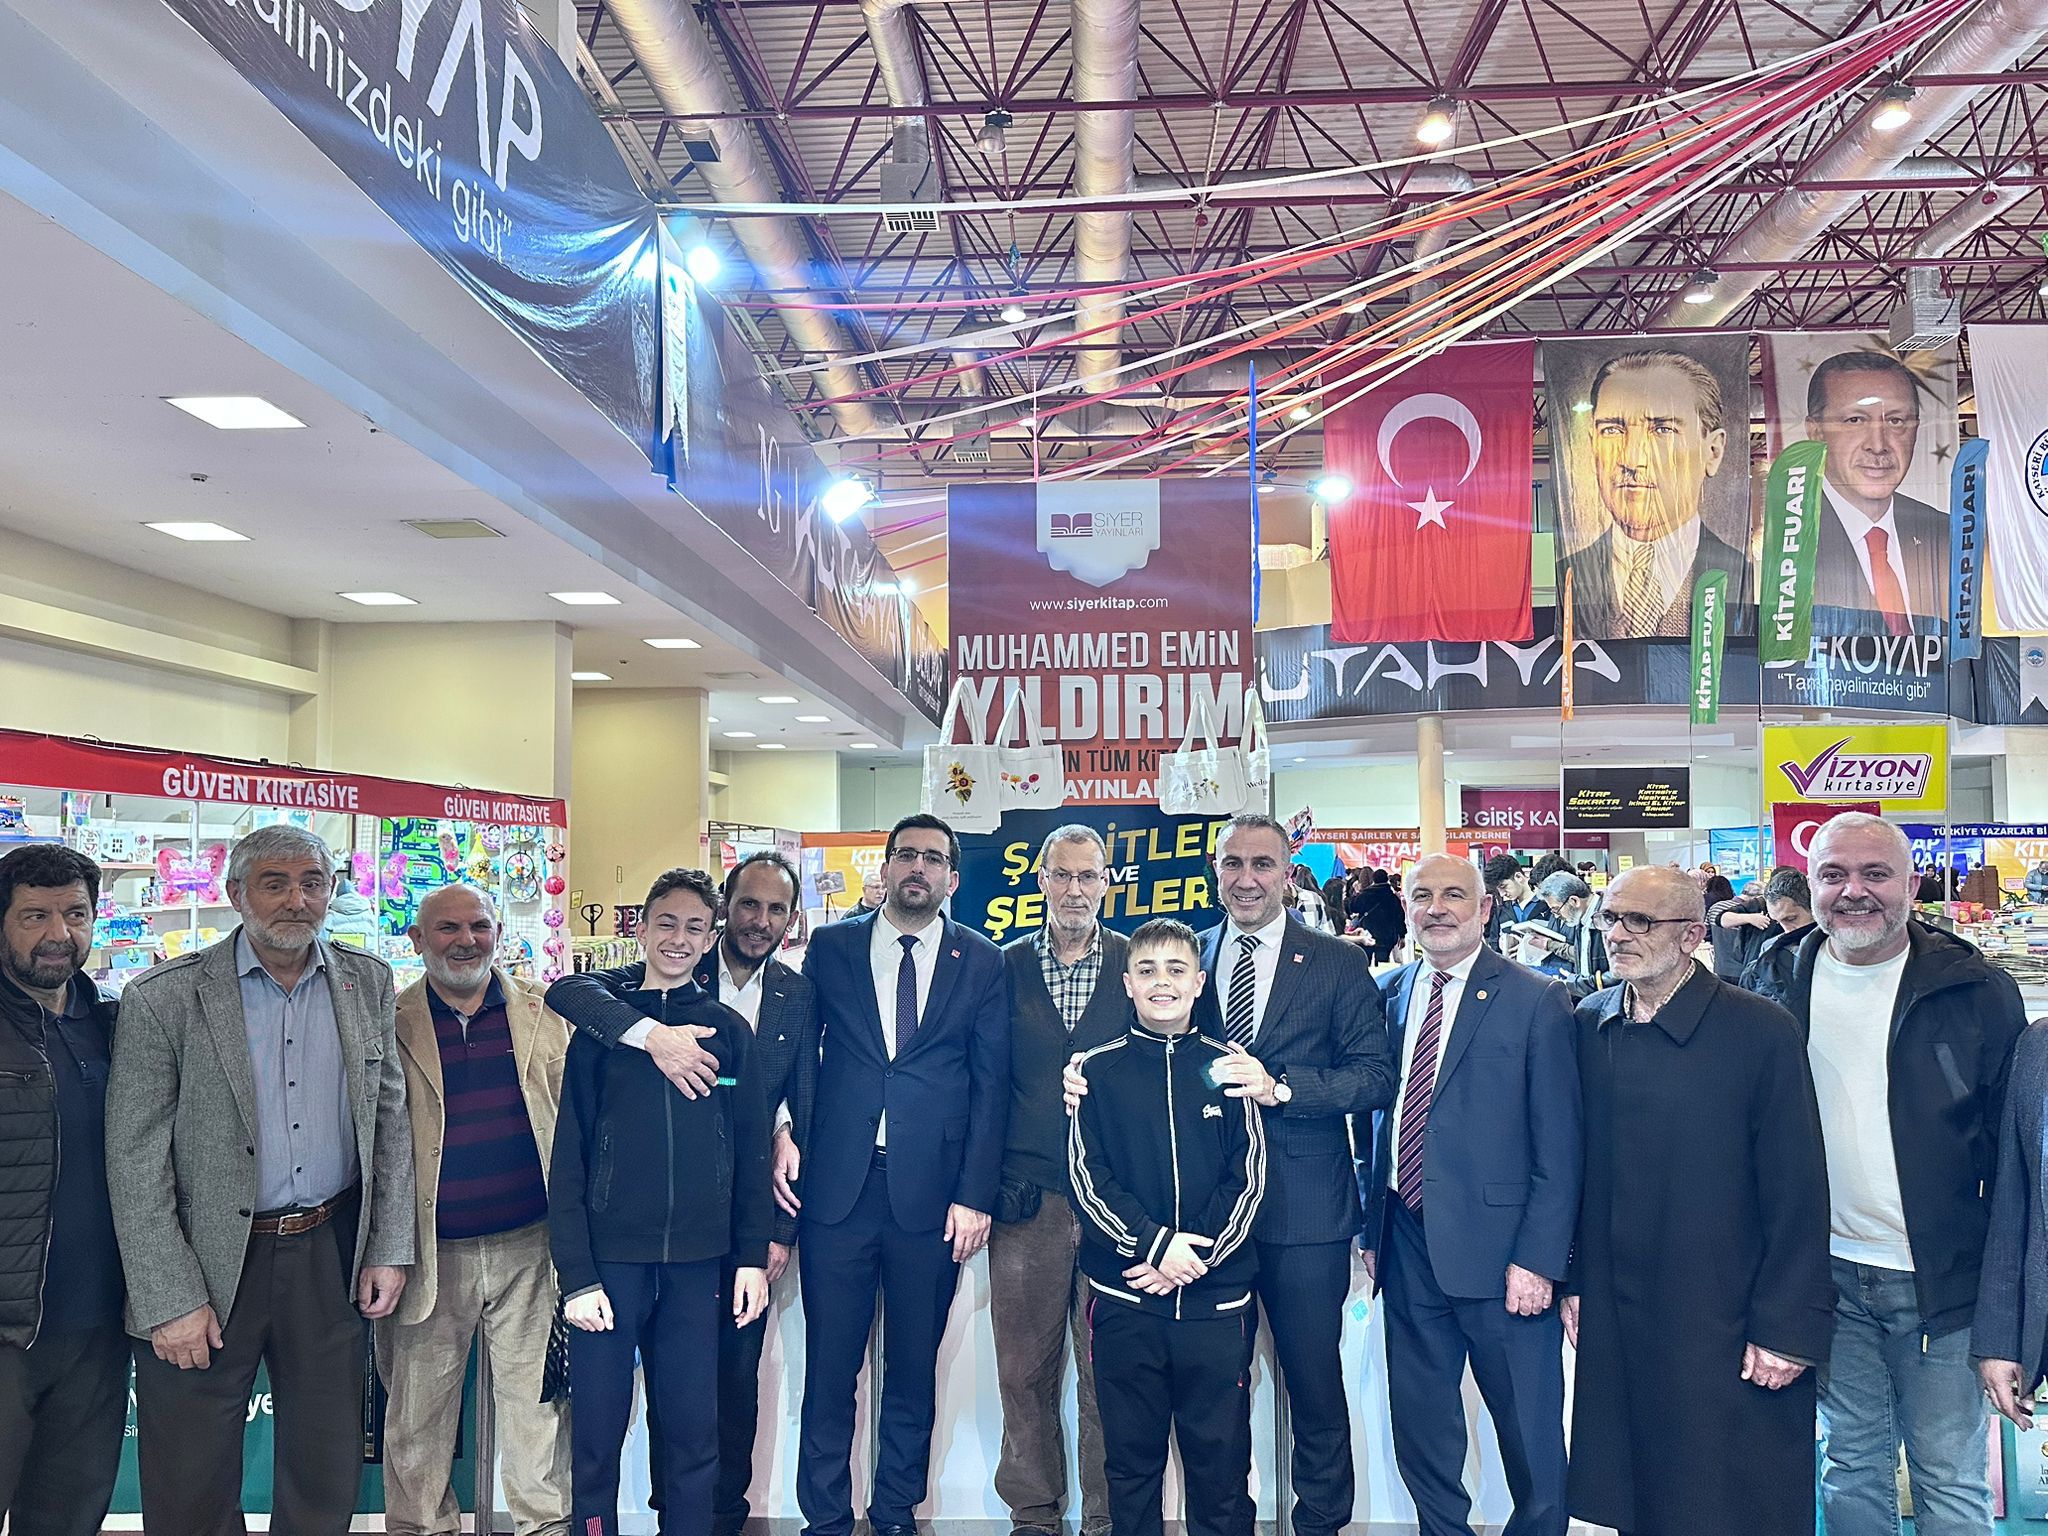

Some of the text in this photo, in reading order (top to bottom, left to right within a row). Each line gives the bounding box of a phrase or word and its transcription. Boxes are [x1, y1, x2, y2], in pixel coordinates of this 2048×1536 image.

[1094, 511, 1143, 527] SİYER
[1095, 527, 1144, 537] YAYINLARI
[1772, 465, 1807, 642] KİTAP FUARI
[1955, 463, 1976, 640] KİTAP FUARI
[1029, 595, 1169, 612] www.siyerkitap.com
[957, 629, 1239, 671] MUHAMMED EMİN
[1695, 587, 1716, 709] KİTAP FUARI
[1764, 635, 1942, 679] EKOYAP
[961, 672, 1243, 741] YILDIRIM
[1087, 745, 1130, 773] TÜM
[162, 763, 359, 810] GÜVEN KIRTASİYE
[1064, 778, 1160, 799] AYINLA
[1824, 778, 1916, 794] kırtasiye
[443, 794, 552, 825] GÜVEN KIRTASİYE
[1474, 806, 1524, 831] GİRİŞ
[1530, 810, 1560, 827] KA
[1351, 831, 1393, 841] ŞAİRLER
[1395, 832, 1408, 840] VE
[1980, 827, 2034, 836] YAZARLAR
[1106, 864, 1140, 883] VE
